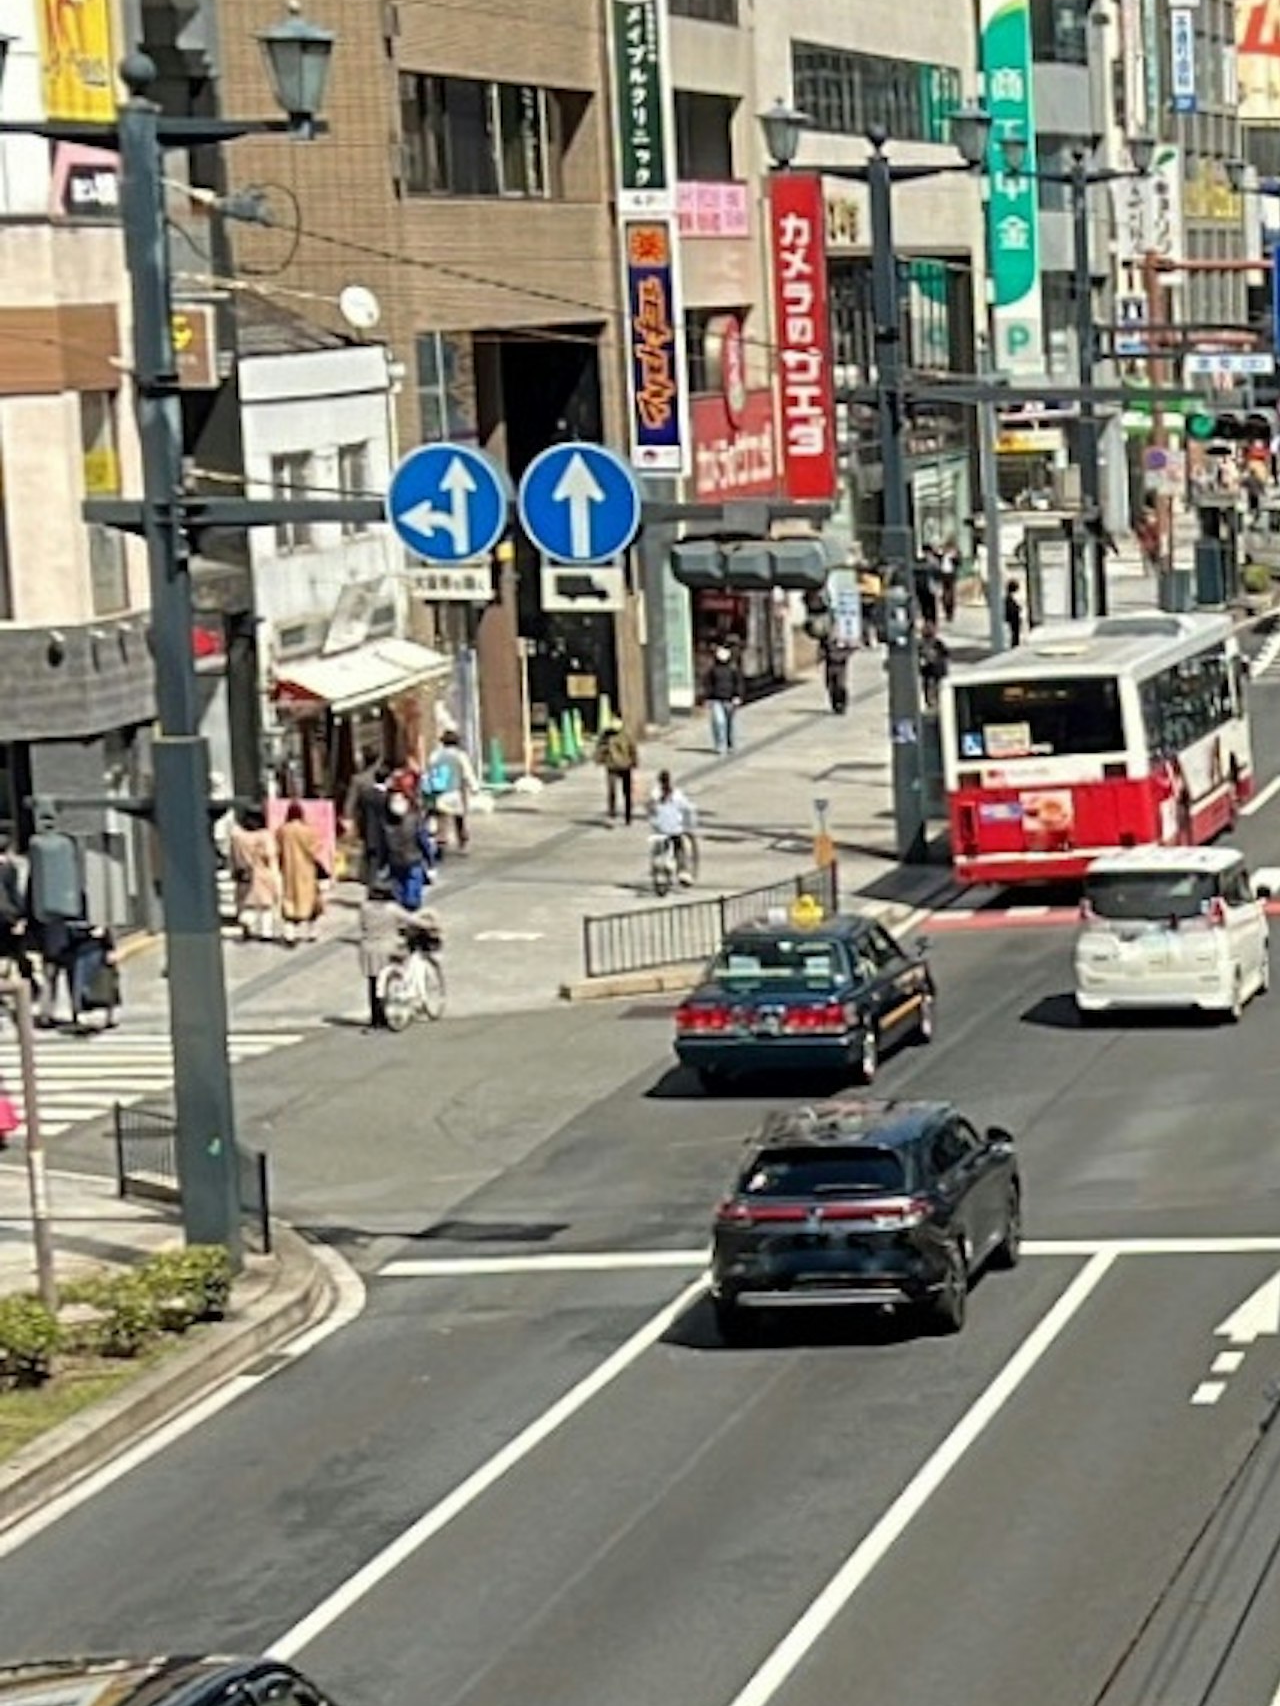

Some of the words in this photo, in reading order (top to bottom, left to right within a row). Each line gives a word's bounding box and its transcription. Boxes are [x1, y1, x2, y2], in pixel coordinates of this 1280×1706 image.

[626, 5, 652, 187] メイプルクリニック
[778, 214, 827, 457] カメラのサエダ
[1005, 325, 1030, 357] P
